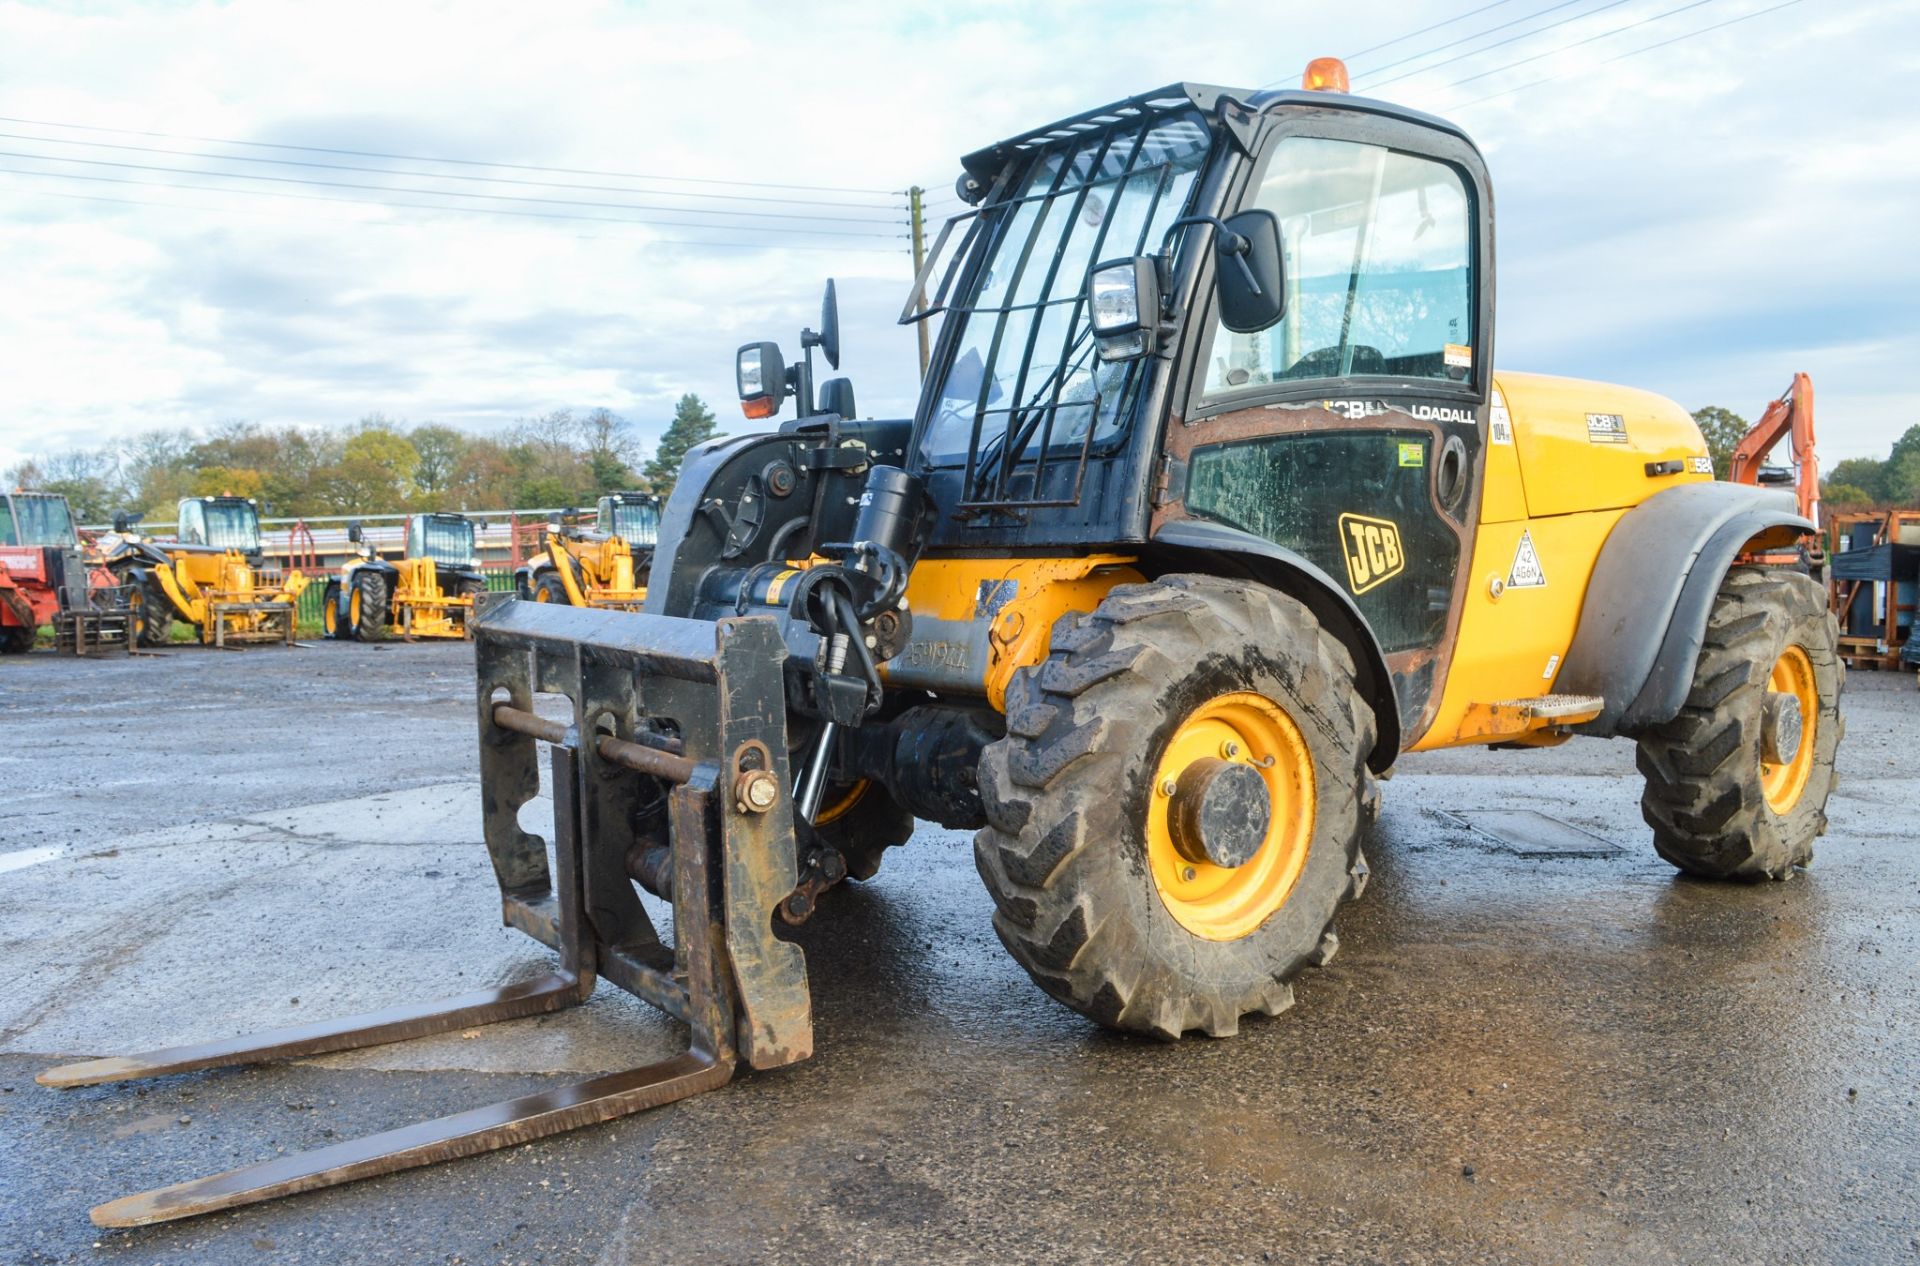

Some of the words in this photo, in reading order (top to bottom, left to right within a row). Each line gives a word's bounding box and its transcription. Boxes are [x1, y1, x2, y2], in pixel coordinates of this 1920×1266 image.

[1411, 404, 1476, 424] LOADALL
[1494, 424, 1506, 441] 104
[1349, 522, 1399, 585] JCB
[1522, 550, 1532, 563] 42
